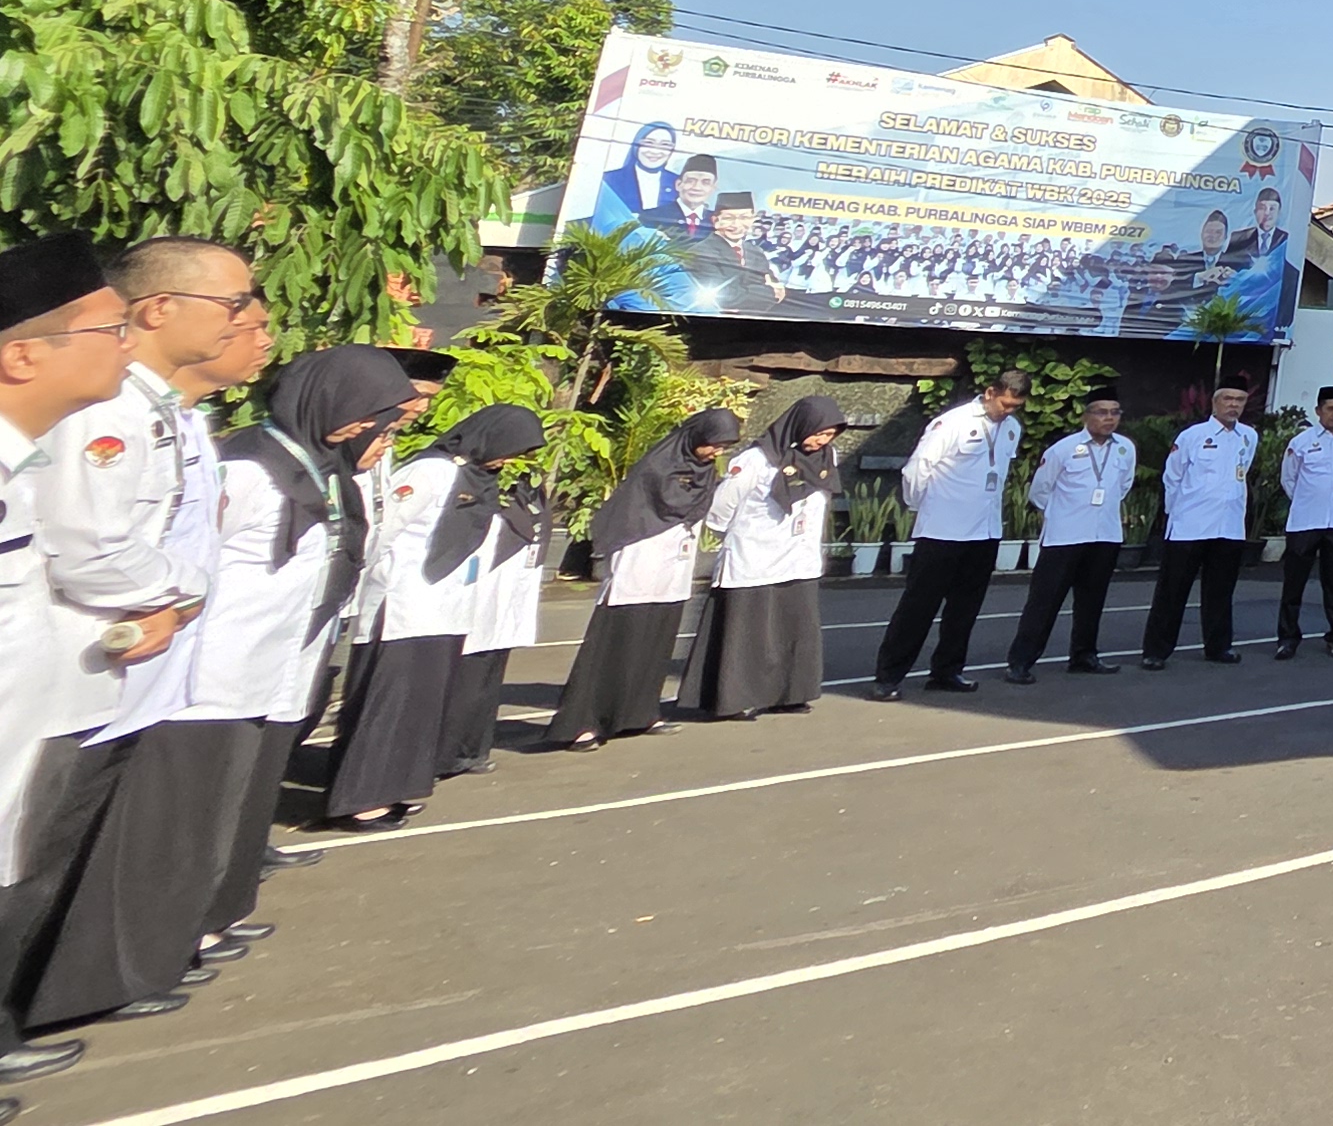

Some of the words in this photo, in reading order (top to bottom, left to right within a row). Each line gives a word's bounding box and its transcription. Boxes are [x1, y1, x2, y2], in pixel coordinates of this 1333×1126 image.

[732, 70, 796, 84] PURBALINGGA
[734, 62, 779, 73] KEMENAG
[880, 112, 988, 139] SELAMAT
[991, 126, 1008, 141] &
[1012, 128, 1096, 152] SUKSES
[684, 118, 789, 146] KANTOR
[793, 131, 960, 166] KEMENTERIAN
[962, 146, 1043, 172] AGAMA
[1047, 158, 1097, 179] KAB.
[1100, 164, 1242, 194] PURBALINGGA
[816, 163, 908, 186] MERAIH
[909, 172, 1022, 198] PREDIKAT
[1025, 183, 1076, 203] WBK
[1078, 188, 1132, 209] 2025
[774, 194, 860, 214] KEMENAG
[862, 204, 901, 218] KAB.
[904, 207, 1020, 229] PURBALINGGA
[1022, 217, 1057, 231] SIAP
[1060, 220, 1106, 235] WBBM
[1108, 224, 1146, 239] 2027
